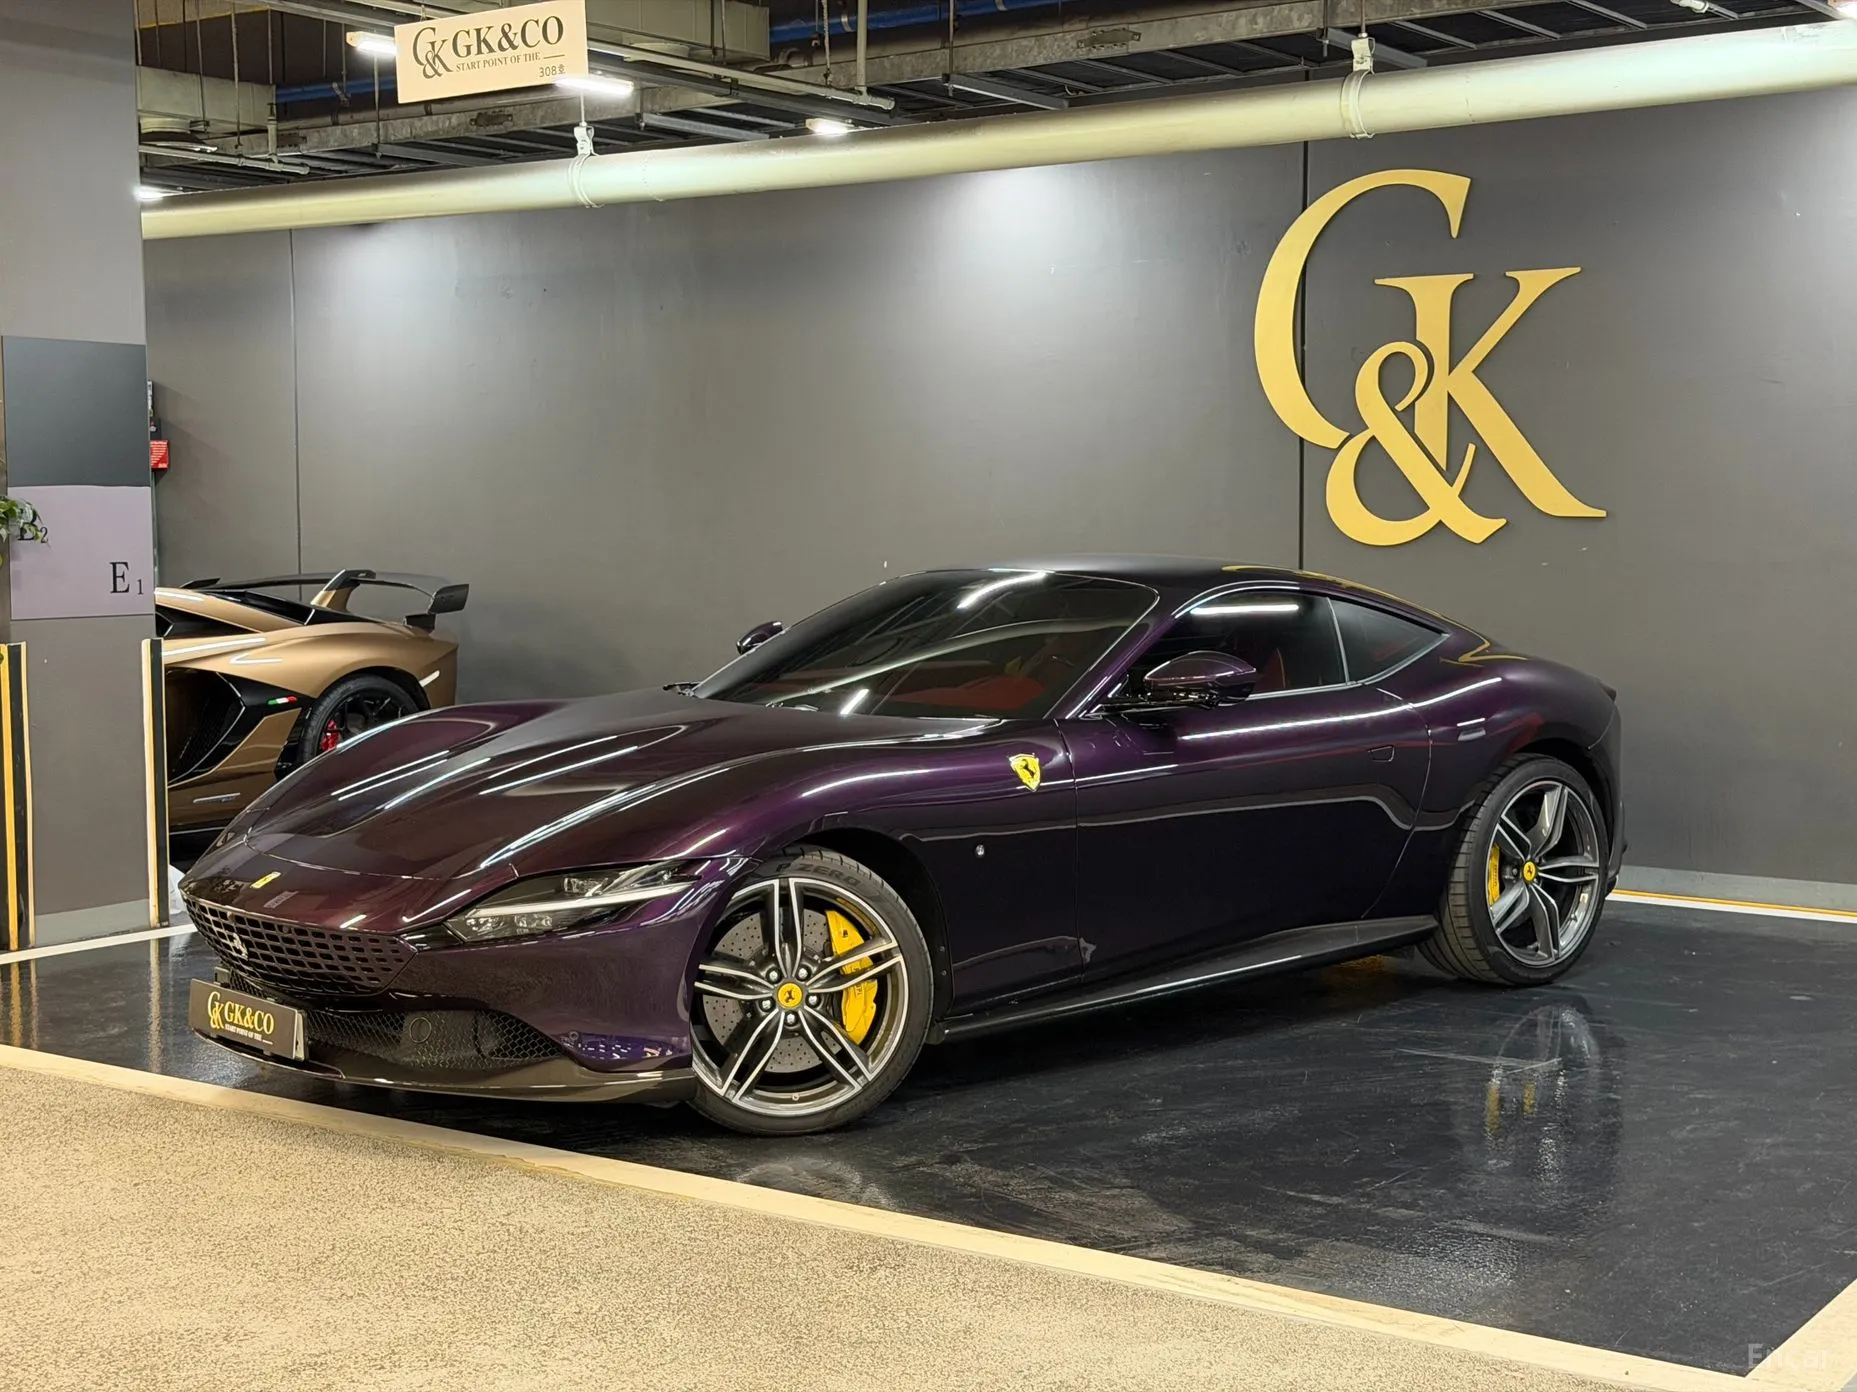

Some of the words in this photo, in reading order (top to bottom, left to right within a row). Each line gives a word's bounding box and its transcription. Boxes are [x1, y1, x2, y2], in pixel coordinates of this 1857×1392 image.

[452, 15, 564, 58] GK&CO
[456, 61, 481, 73] START
[483, 56, 508, 69] POINT
[510, 54, 521, 64] OF
[523, 52, 541, 62] THE
[224, 1001, 274, 1035] GK&CO
